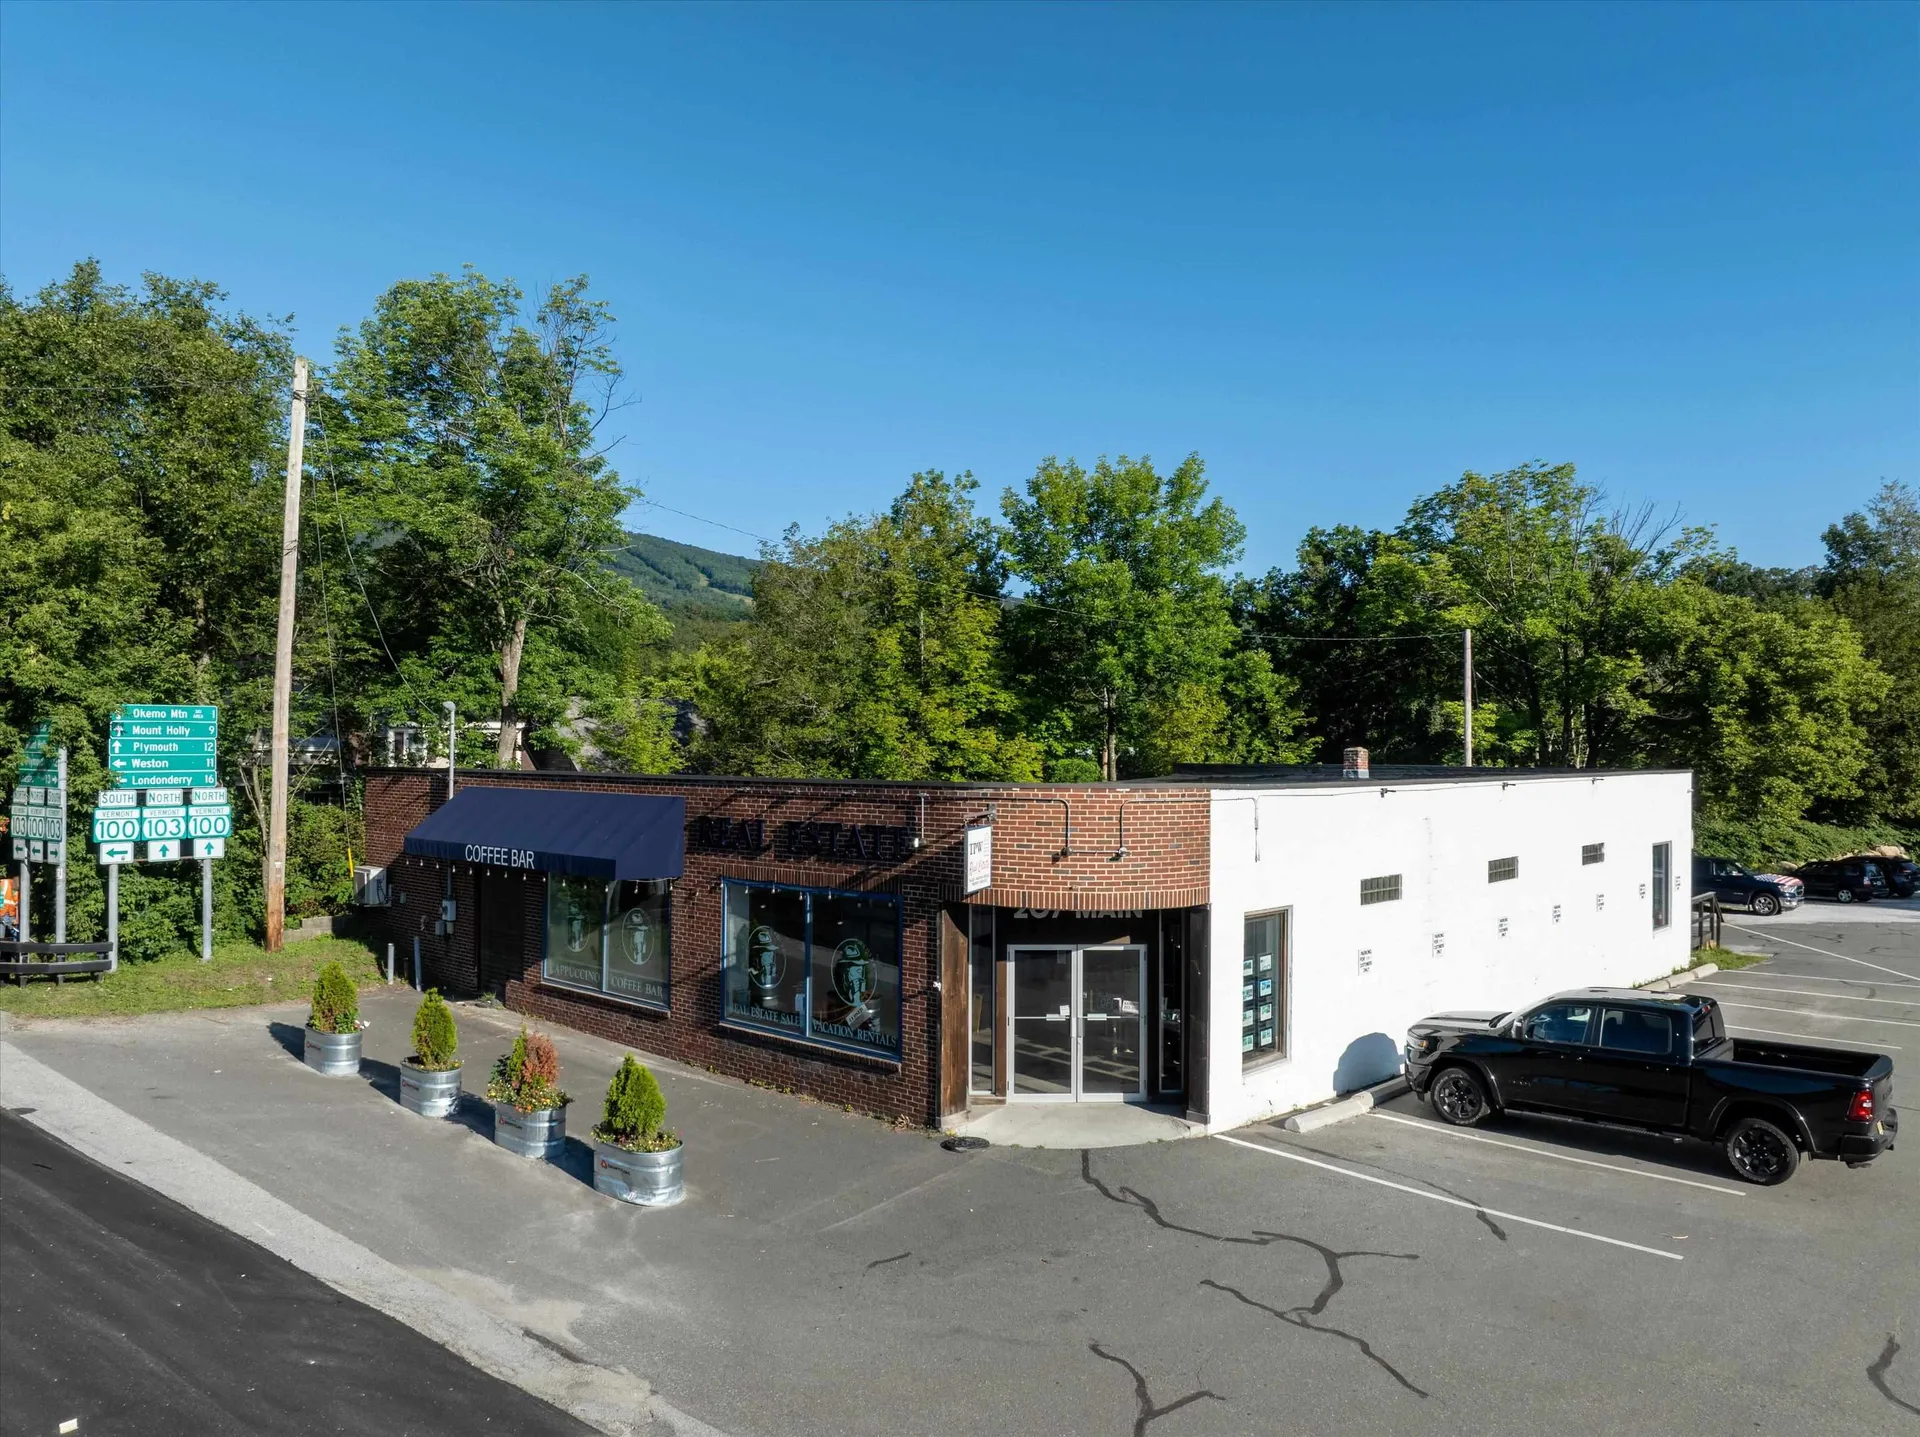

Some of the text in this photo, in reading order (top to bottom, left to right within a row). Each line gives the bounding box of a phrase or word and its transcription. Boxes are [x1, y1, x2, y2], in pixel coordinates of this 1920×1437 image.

[133, 708, 188, 719] Okemo Mtn
[132, 725, 215, 737] Mount Holly 9
[133, 742, 214, 754] Plymouth 12
[131, 758, 214, 768] Weston 11
[132, 774, 214, 787] Londonderry 16
[101, 791, 134, 804] SOUTH
[149, 791, 183, 804] NORTH
[194, 790, 225, 802] NORTH
[102, 810, 134, 818] VERMONT
[149, 808, 180, 816] VERMONT
[195, 807, 224, 815] VERMONT
[12, 816, 26, 835] 103
[29, 818, 44, 837] 100
[47, 819, 61, 839] 103
[99, 820, 136, 839] 100
[147, 818, 182, 837] 103
[193, 816, 226, 835] 100
[465, 844, 535, 870] COFFEE BAR
[549, 963, 601, 984] APPUCCINO
[611, 976, 664, 998] COFFEE BAR
[730, 1002, 804, 1028] EAL ESTATE SALE
[811, 1019, 897, 1048] VACATION RENTALS
